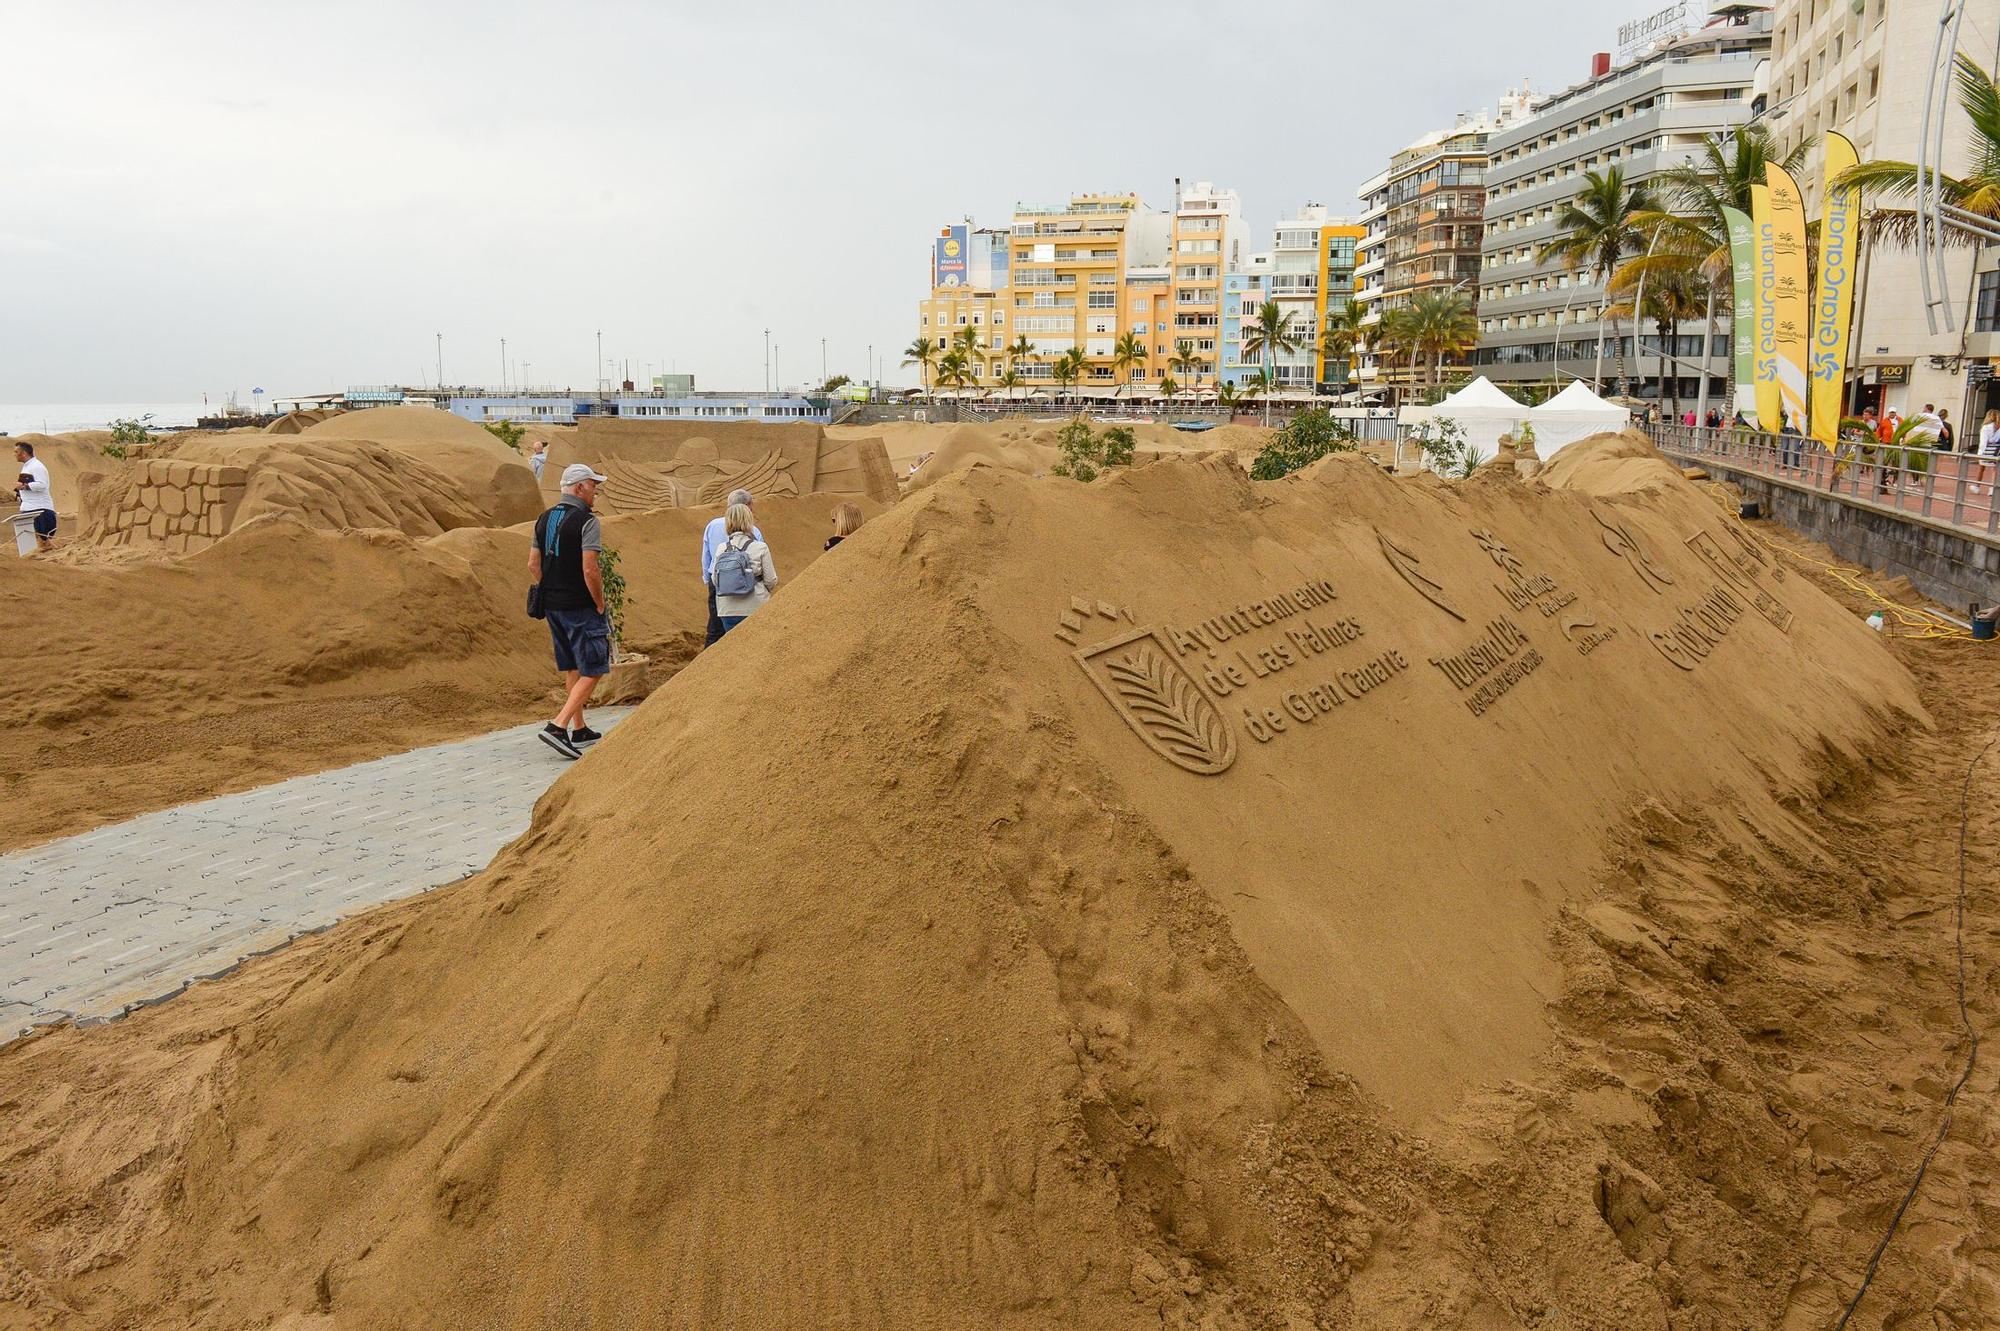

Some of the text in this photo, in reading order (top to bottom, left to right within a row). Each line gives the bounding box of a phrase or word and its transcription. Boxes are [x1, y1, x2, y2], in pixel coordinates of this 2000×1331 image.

[1881, 366, 1903, 376] 100
[1163, 580, 1337, 659] Ayuntamiento
[1203, 615, 1365, 696] de Las Palmas
[1244, 648, 1409, 742] de Gran Canaria
